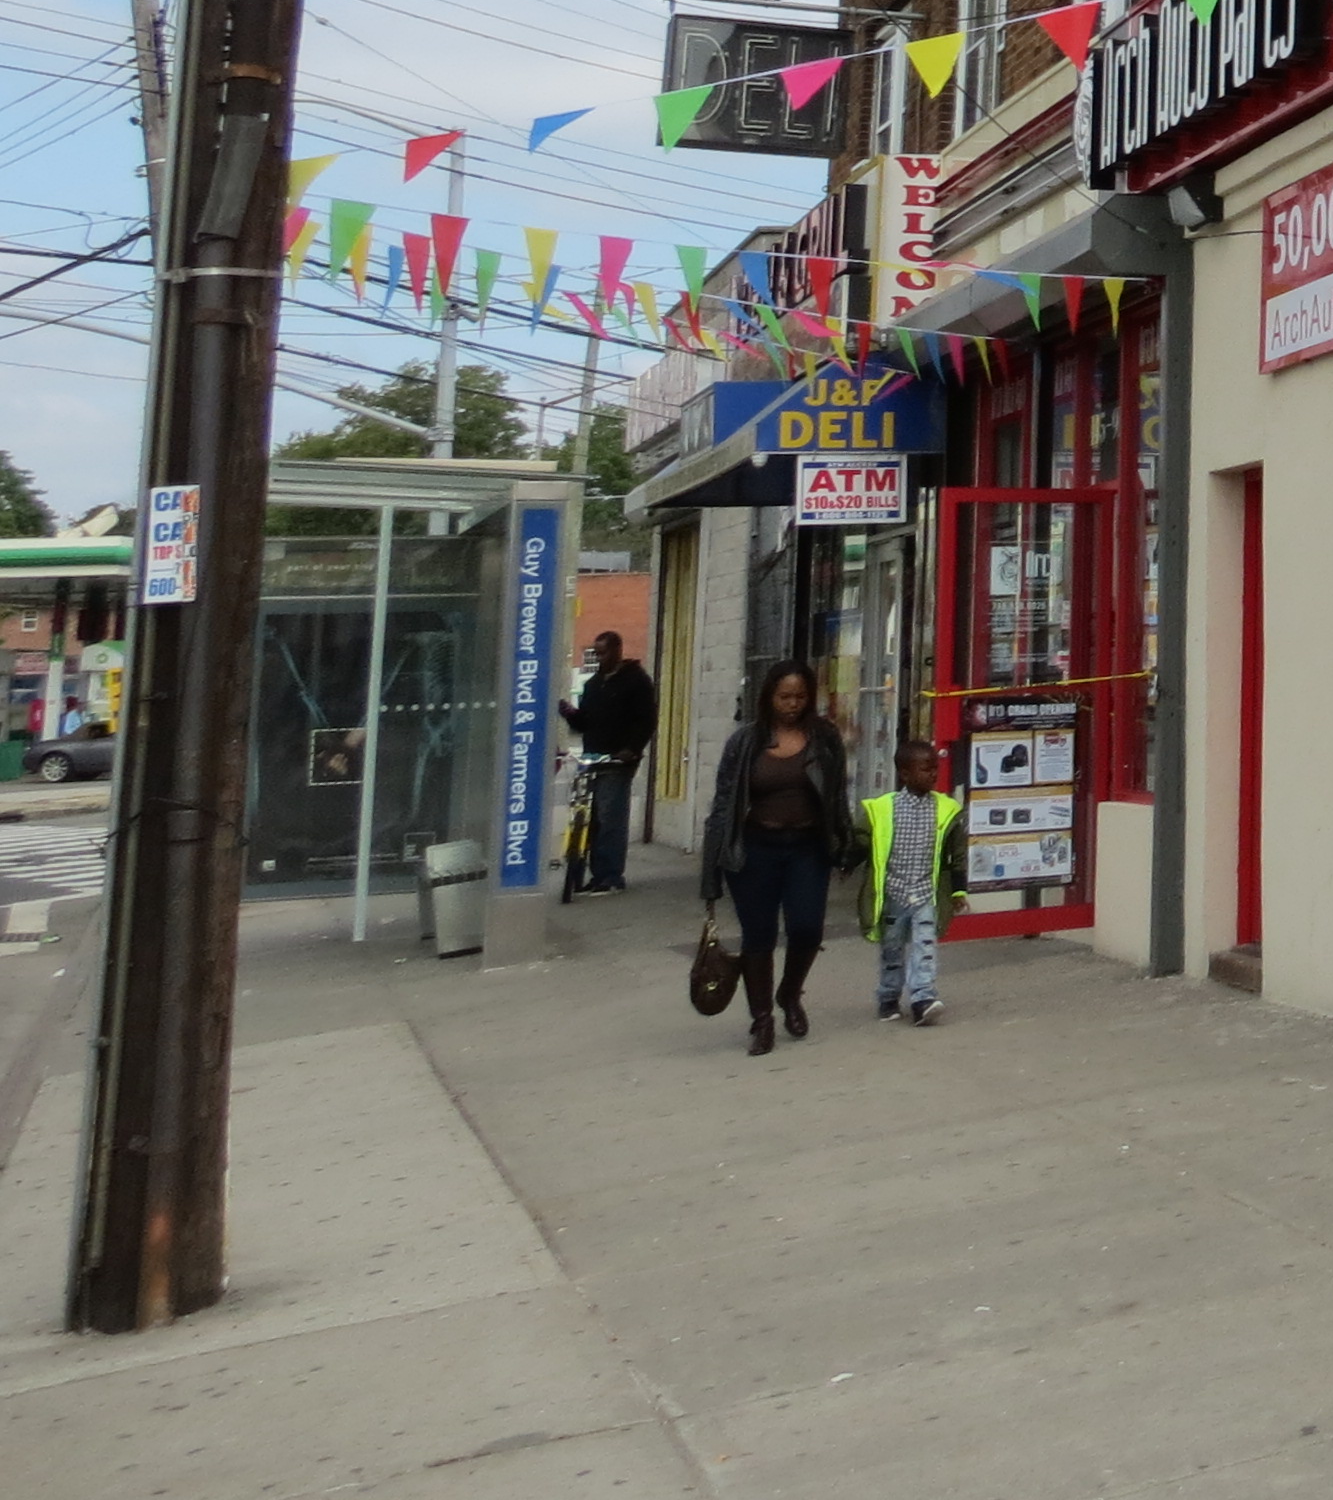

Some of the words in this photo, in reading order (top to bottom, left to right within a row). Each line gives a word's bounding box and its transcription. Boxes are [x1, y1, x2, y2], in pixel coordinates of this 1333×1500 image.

[676, 28, 843, 141] DELI
[1100, 11, 1151, 172] Arch
[804, 378, 883, 407] J&F
[778, 410, 896, 449] DELI
[807, 468, 897, 493] ATM
[866, 495, 899, 508] BILLS
[520, 536, 546, 577] Guy
[516, 583, 543, 655] Brewer
[515, 659, 539, 704] Blvd
[514, 710, 536, 725] &
[508, 730, 535, 815] Farmers
[506, 819, 530, 867] Blvd
